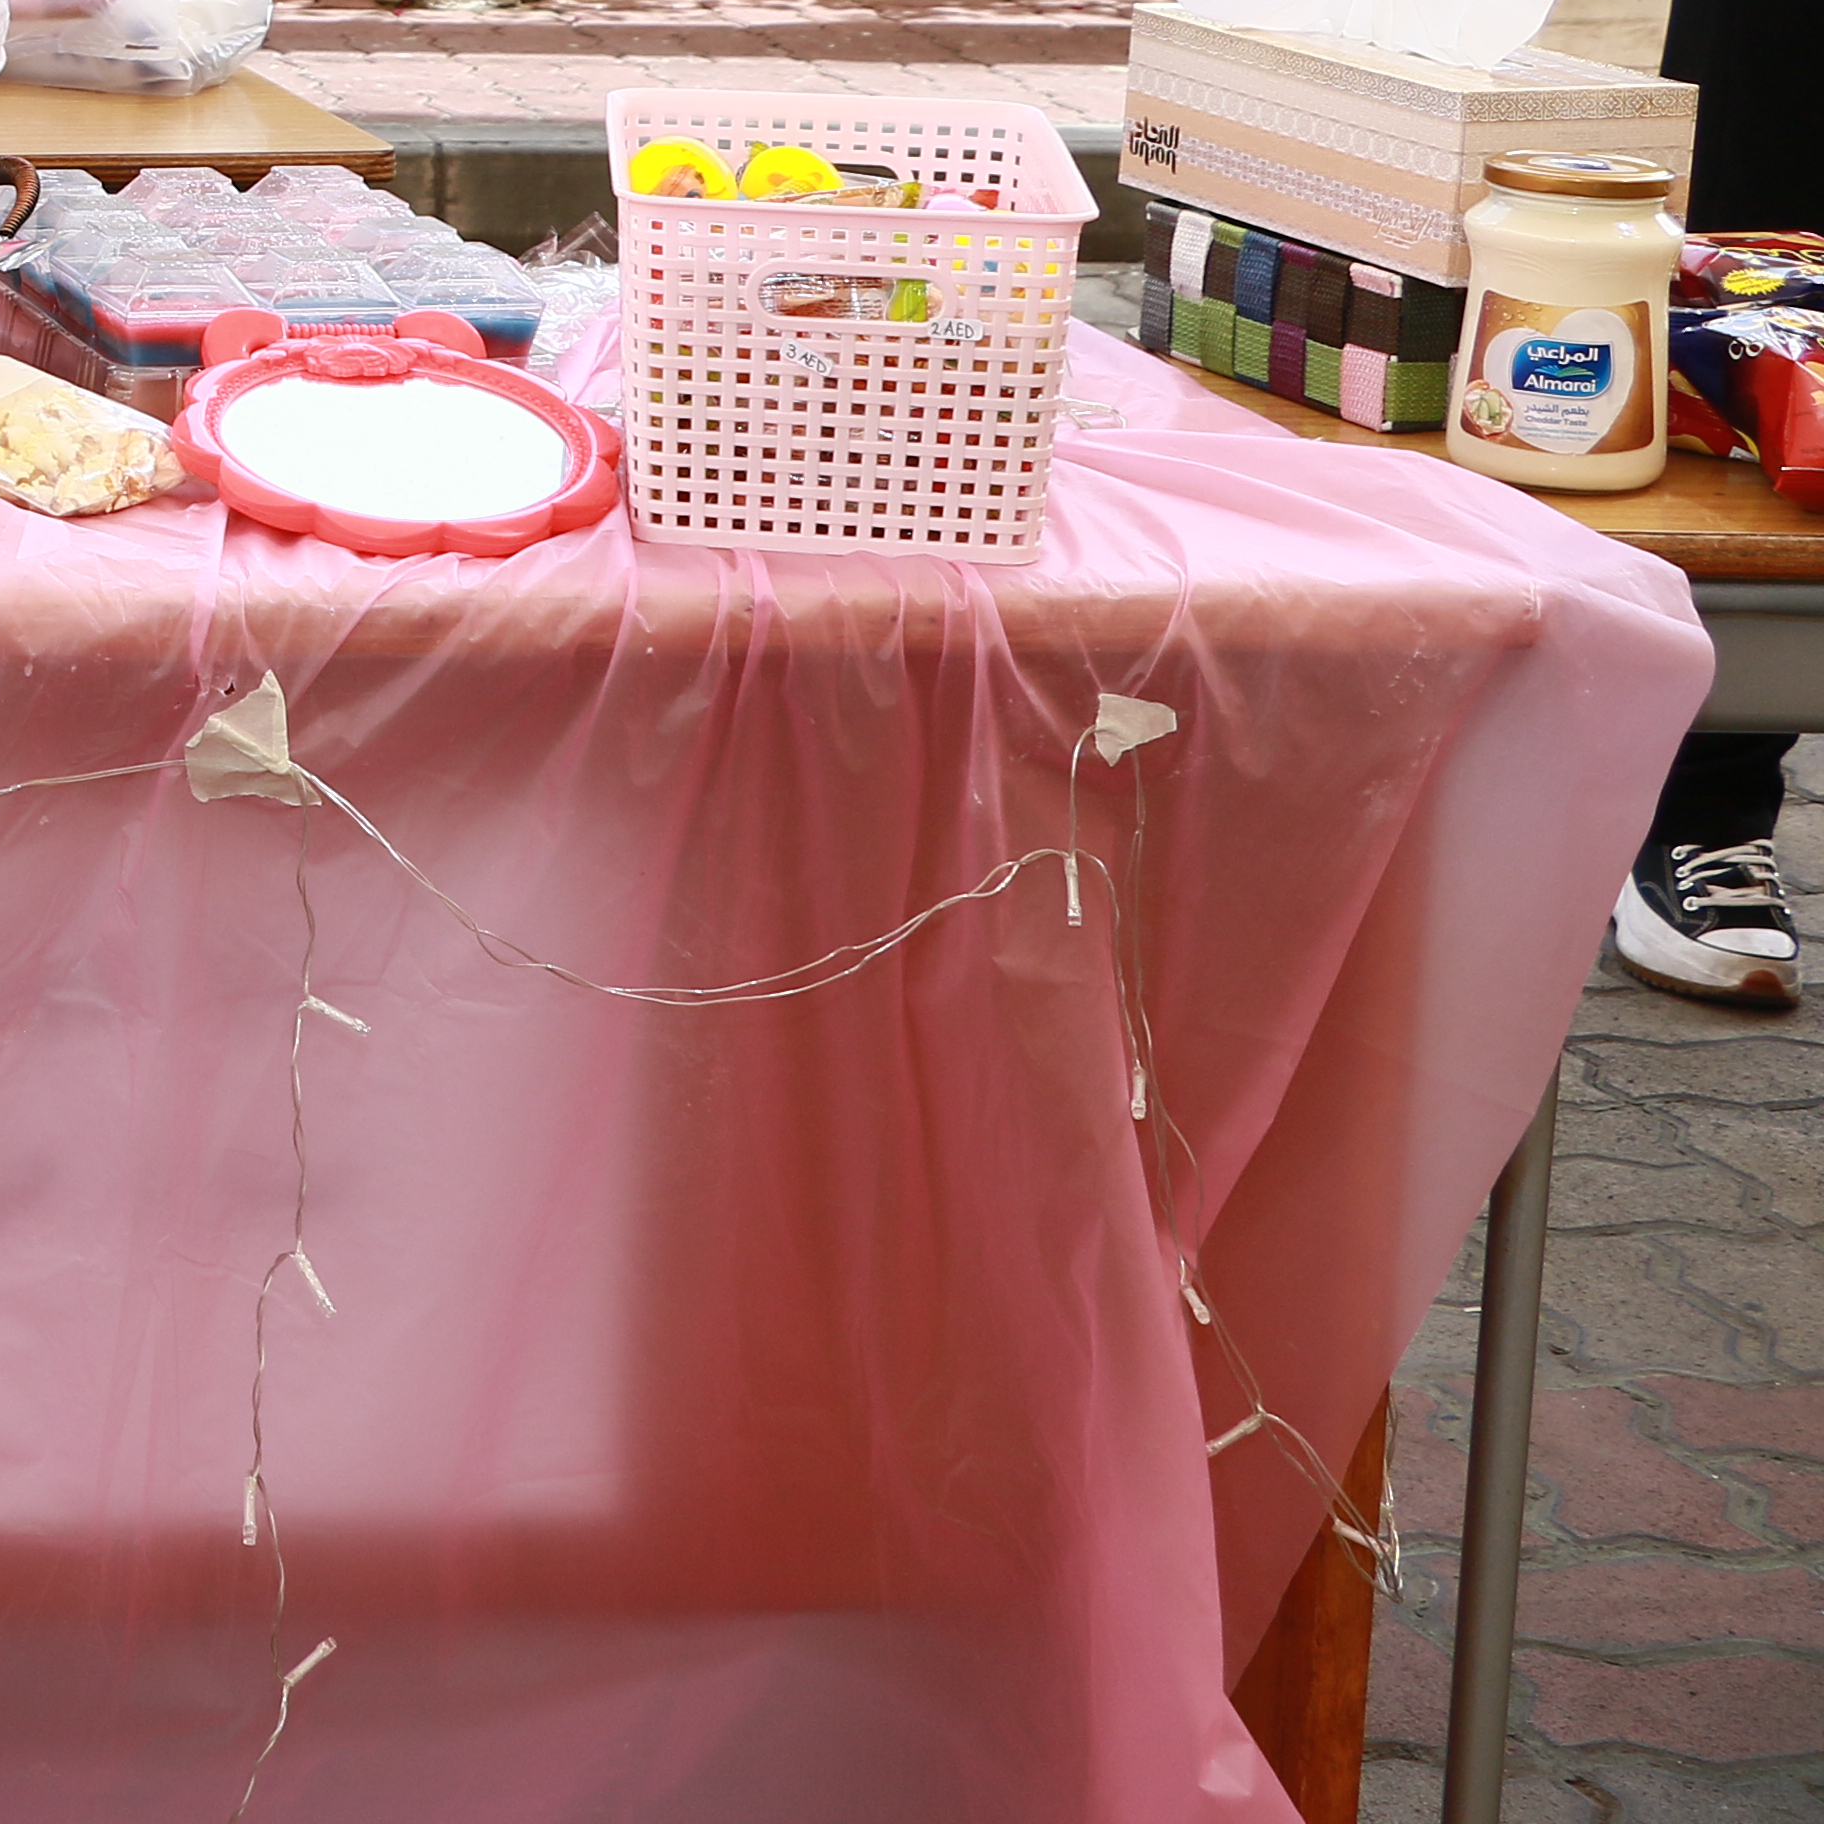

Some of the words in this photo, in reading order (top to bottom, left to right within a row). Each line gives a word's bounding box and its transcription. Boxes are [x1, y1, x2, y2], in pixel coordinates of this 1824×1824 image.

[931, 321, 941, 336] 2
[943, 320, 975, 339] AED
[785, 343, 797, 359] 3
[798, 352, 828, 374] AED
[1526, 344, 1599, 366] المراعي
[1524, 374, 1597, 393] Almarai
[1525, 416, 1562, 426] Cheddar
[1564, 417, 1588, 427] Taste
